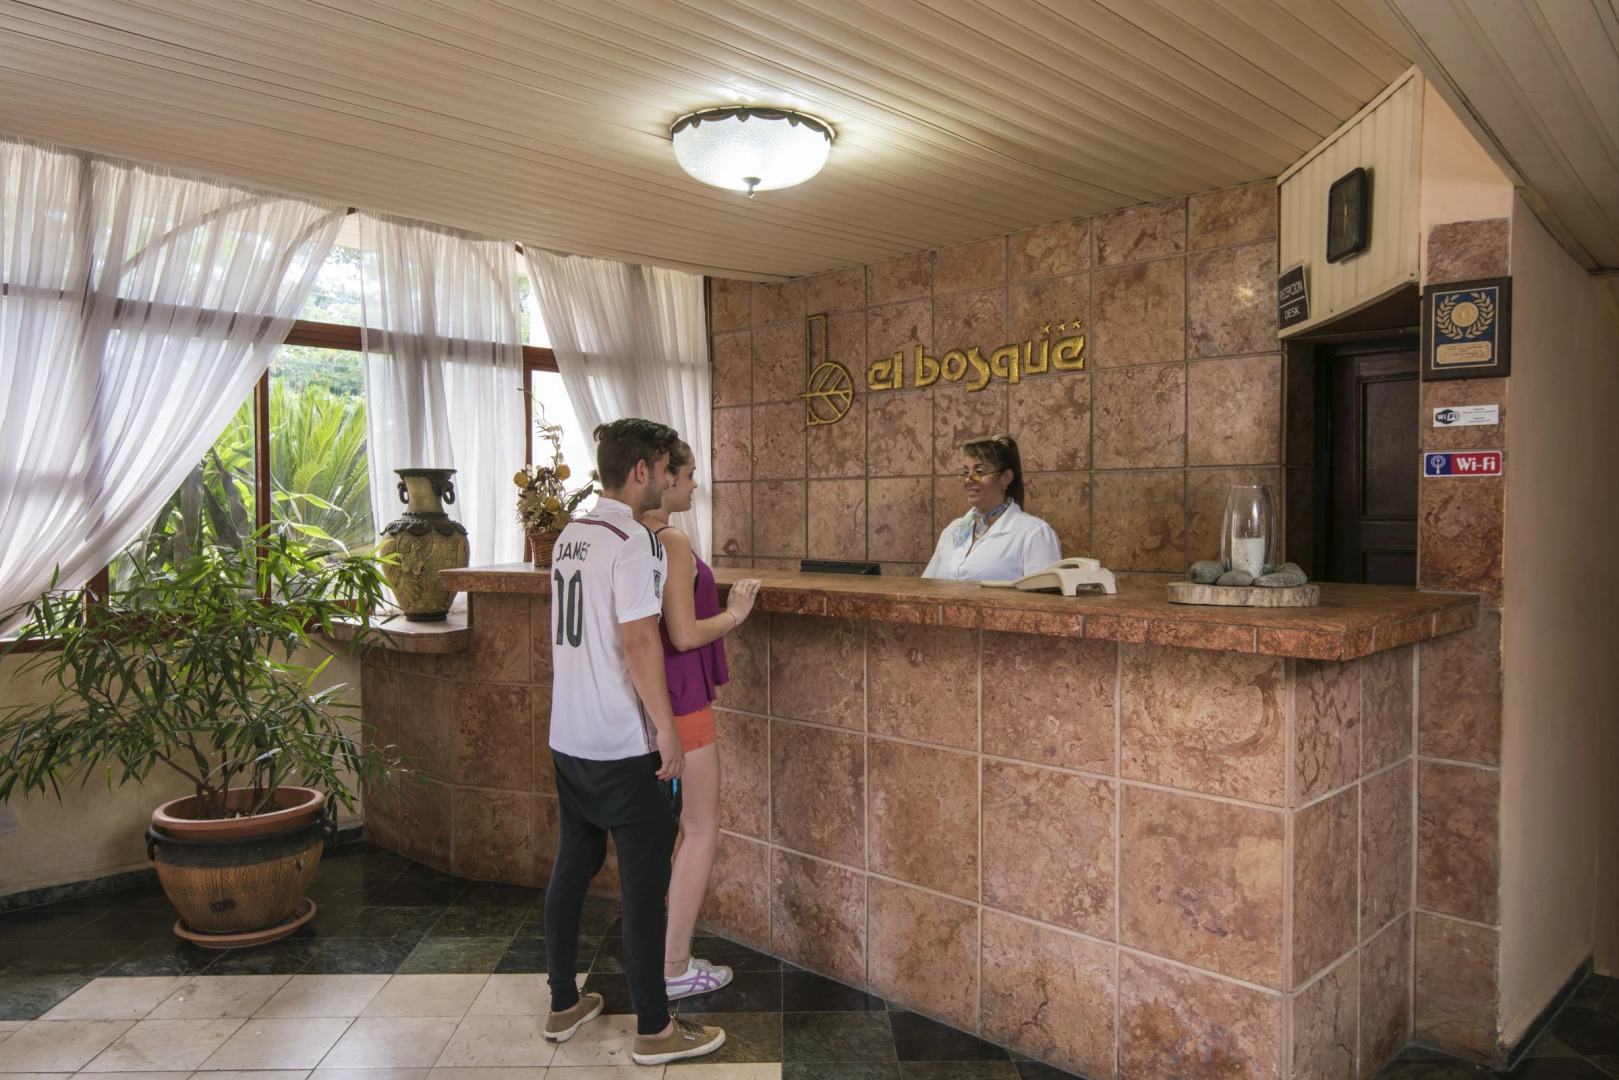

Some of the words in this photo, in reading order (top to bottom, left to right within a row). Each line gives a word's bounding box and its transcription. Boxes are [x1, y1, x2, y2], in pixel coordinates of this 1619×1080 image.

[1284, 305, 1301, 320] DESK
[867, 351, 903, 391] el
[914, 335, 1085, 393] bosque
[1456, 456, 1496, 472] Wi-Fi
[554, 568, 583, 648] 10
